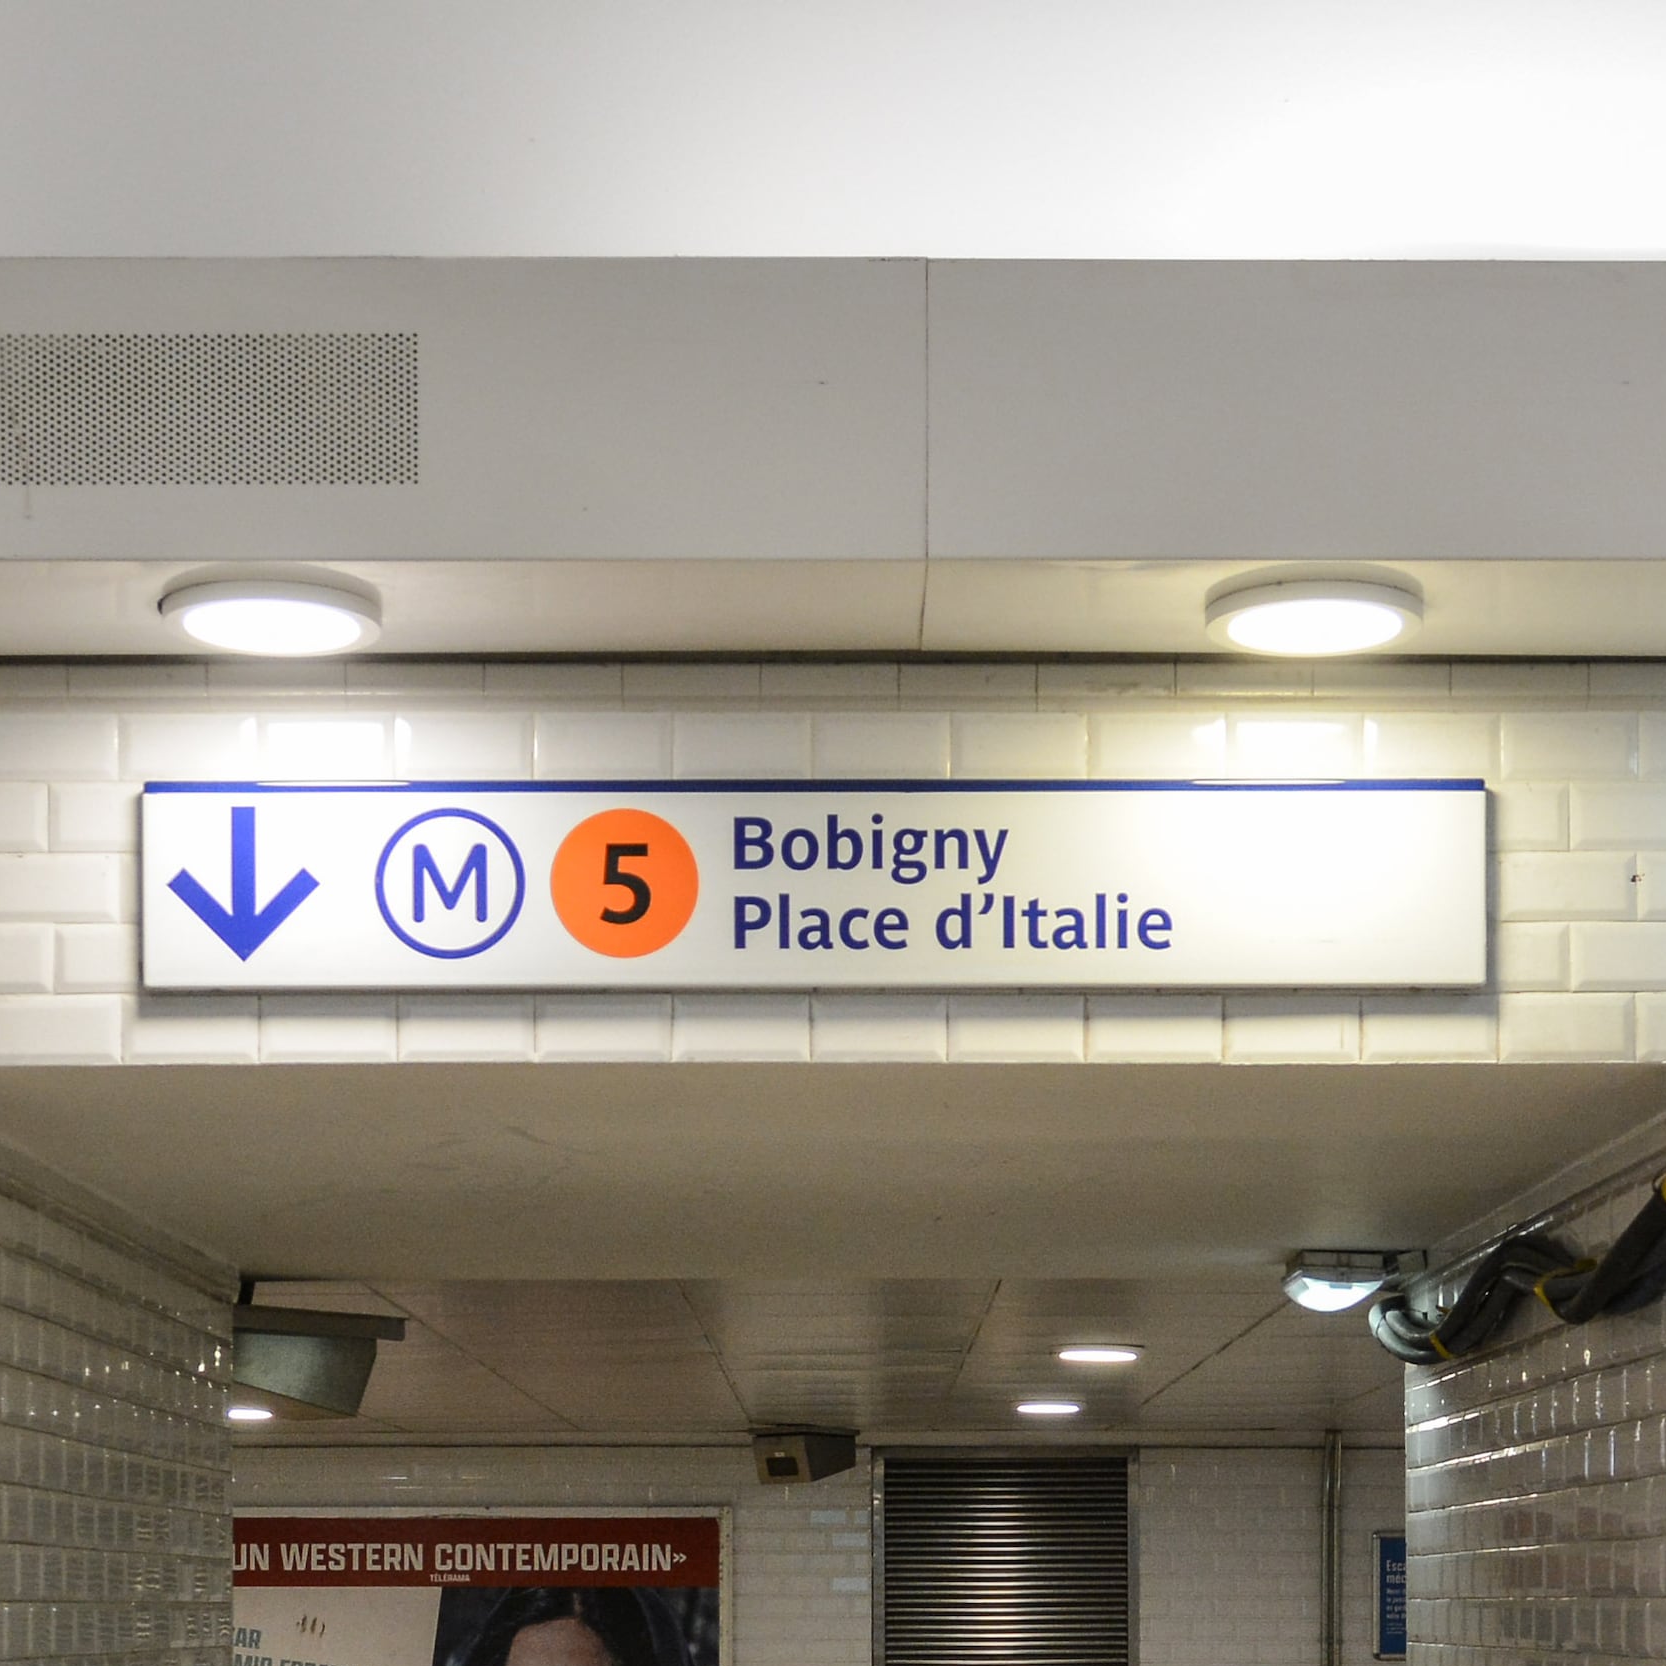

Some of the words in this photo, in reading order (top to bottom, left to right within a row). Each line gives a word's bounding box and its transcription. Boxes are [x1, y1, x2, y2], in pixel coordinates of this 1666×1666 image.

[411, 842, 488, 924] M
[599, 843, 653, 926] 5
[732, 816, 1010, 884] Bobigny
[732, 895, 910, 951] Place
[933, 892, 1174, 951] d’Italie
[280, 1543, 424, 1571] WESTERN
